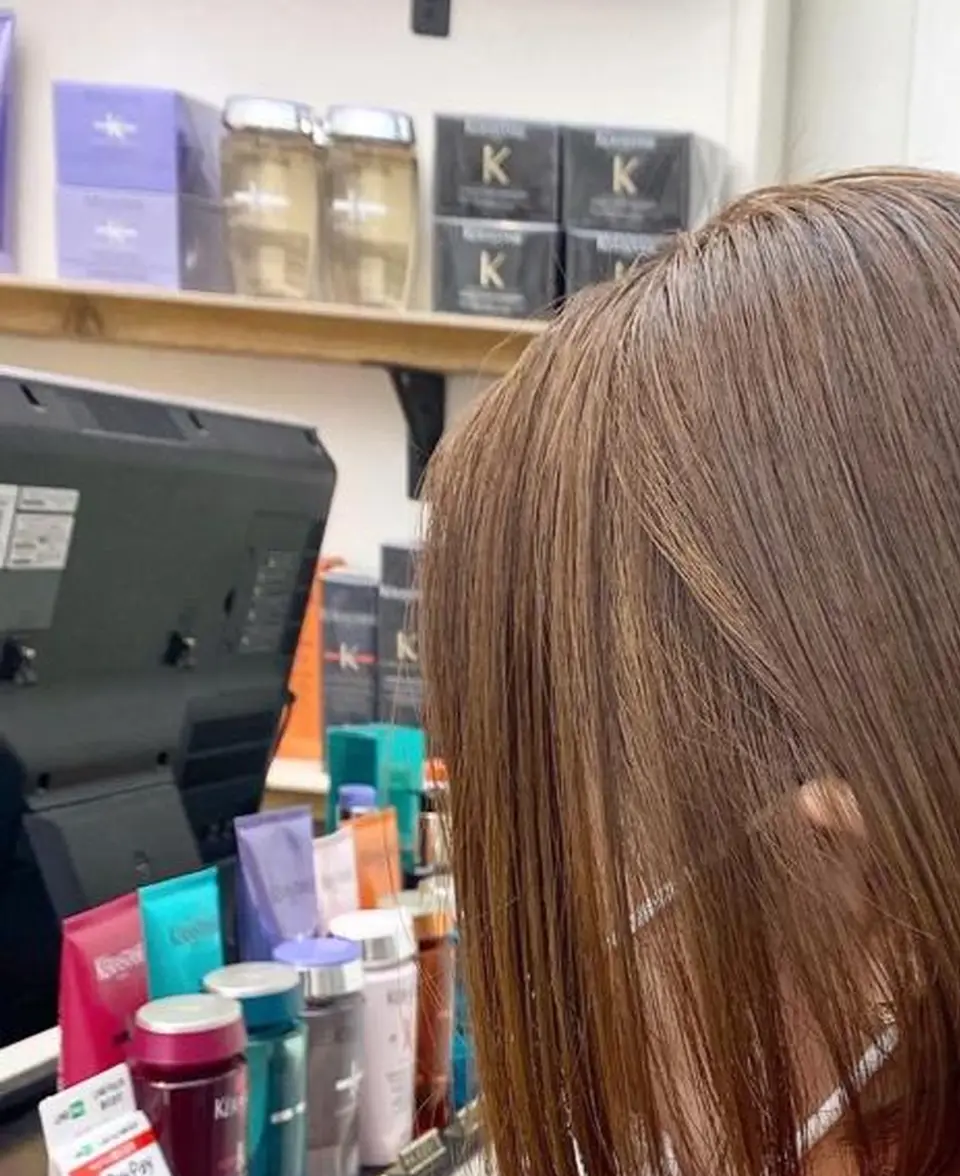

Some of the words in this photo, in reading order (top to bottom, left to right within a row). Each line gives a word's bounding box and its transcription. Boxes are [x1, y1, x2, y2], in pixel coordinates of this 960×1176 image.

[482, 143, 511, 186] K
[612, 155, 639, 195] K
[480, 249, 505, 289] K
